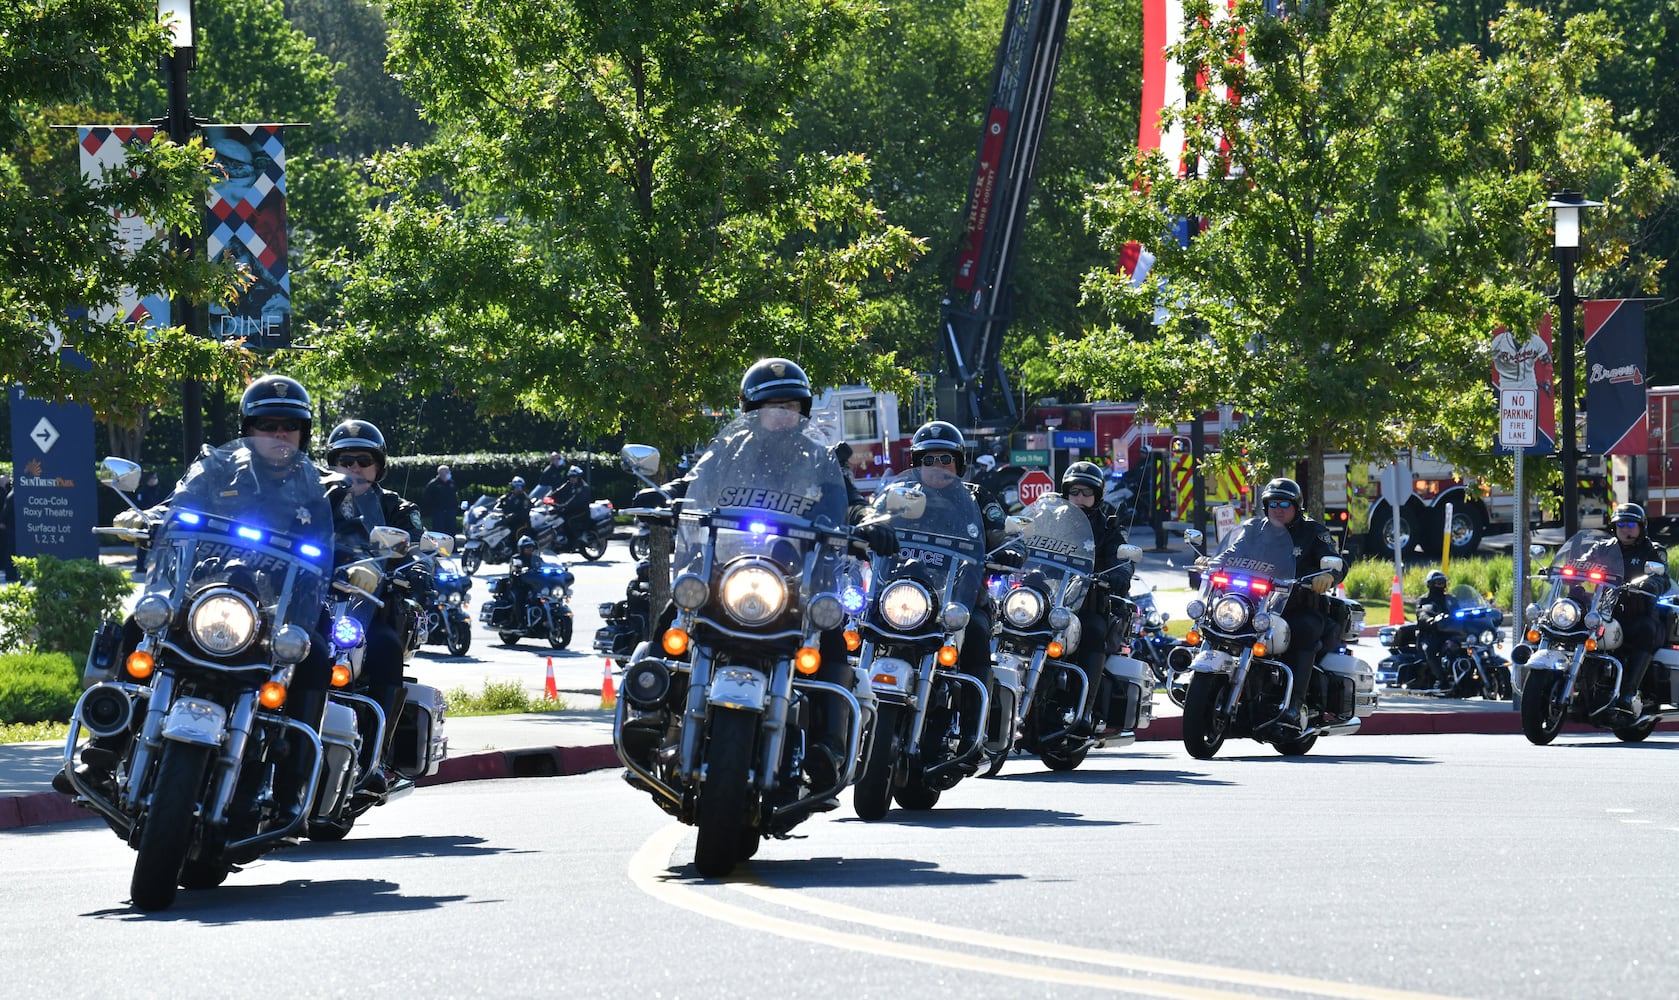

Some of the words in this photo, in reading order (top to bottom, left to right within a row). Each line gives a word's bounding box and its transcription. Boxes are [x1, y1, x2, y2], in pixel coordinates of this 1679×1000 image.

[983, 170, 995, 204] COUNTY
[967, 175, 984, 232] TRUCK
[980, 161, 989, 171] 4
[219, 315, 281, 337] DINE
[1590, 363, 1635, 383] Braves
[1511, 395, 1525, 407] NO
[1503, 408, 1533, 420] PARKING
[1510, 421, 1526, 430] FIRE
[1508, 431, 1527, 440] LANE
[1021, 483, 1052, 500] STOP
[28, 496, 68, 505] Coca-Cola
[718, 486, 816, 516] SHERIFF
[23, 507, 43, 518] Roxy
[45, 508, 73, 517] Theatre
[27, 523, 57, 533] Surface
[58, 524, 71, 534] Lot
[58, 535, 65, 543] 4
[200, 541, 286, 571] SHERIFF
[898, 547, 945, 567] OLICE
[1225, 556, 1276, 573] SHERIFF
